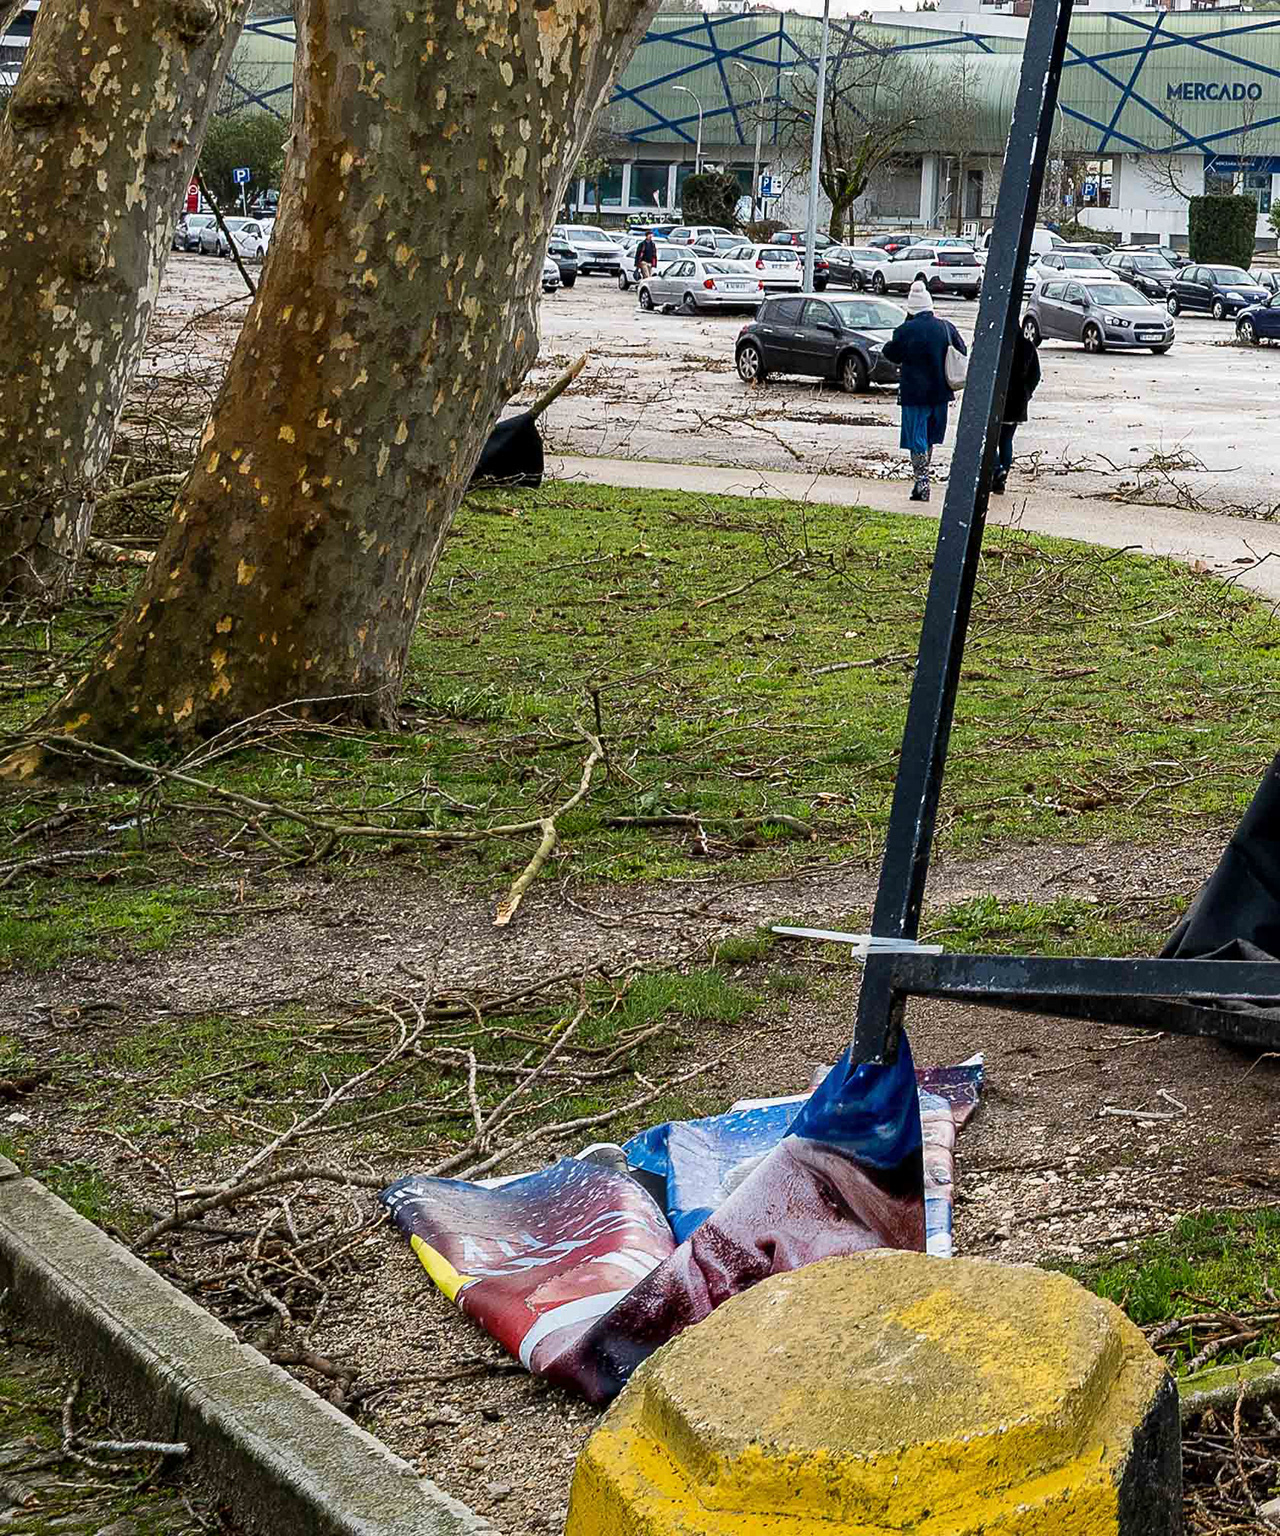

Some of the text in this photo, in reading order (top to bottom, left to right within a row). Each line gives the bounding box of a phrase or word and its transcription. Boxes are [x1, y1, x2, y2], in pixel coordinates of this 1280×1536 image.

[1166, 82, 1263, 101] MERCADO
[236, 170, 246, 182] P
[1084, 184, 1093, 195] P
